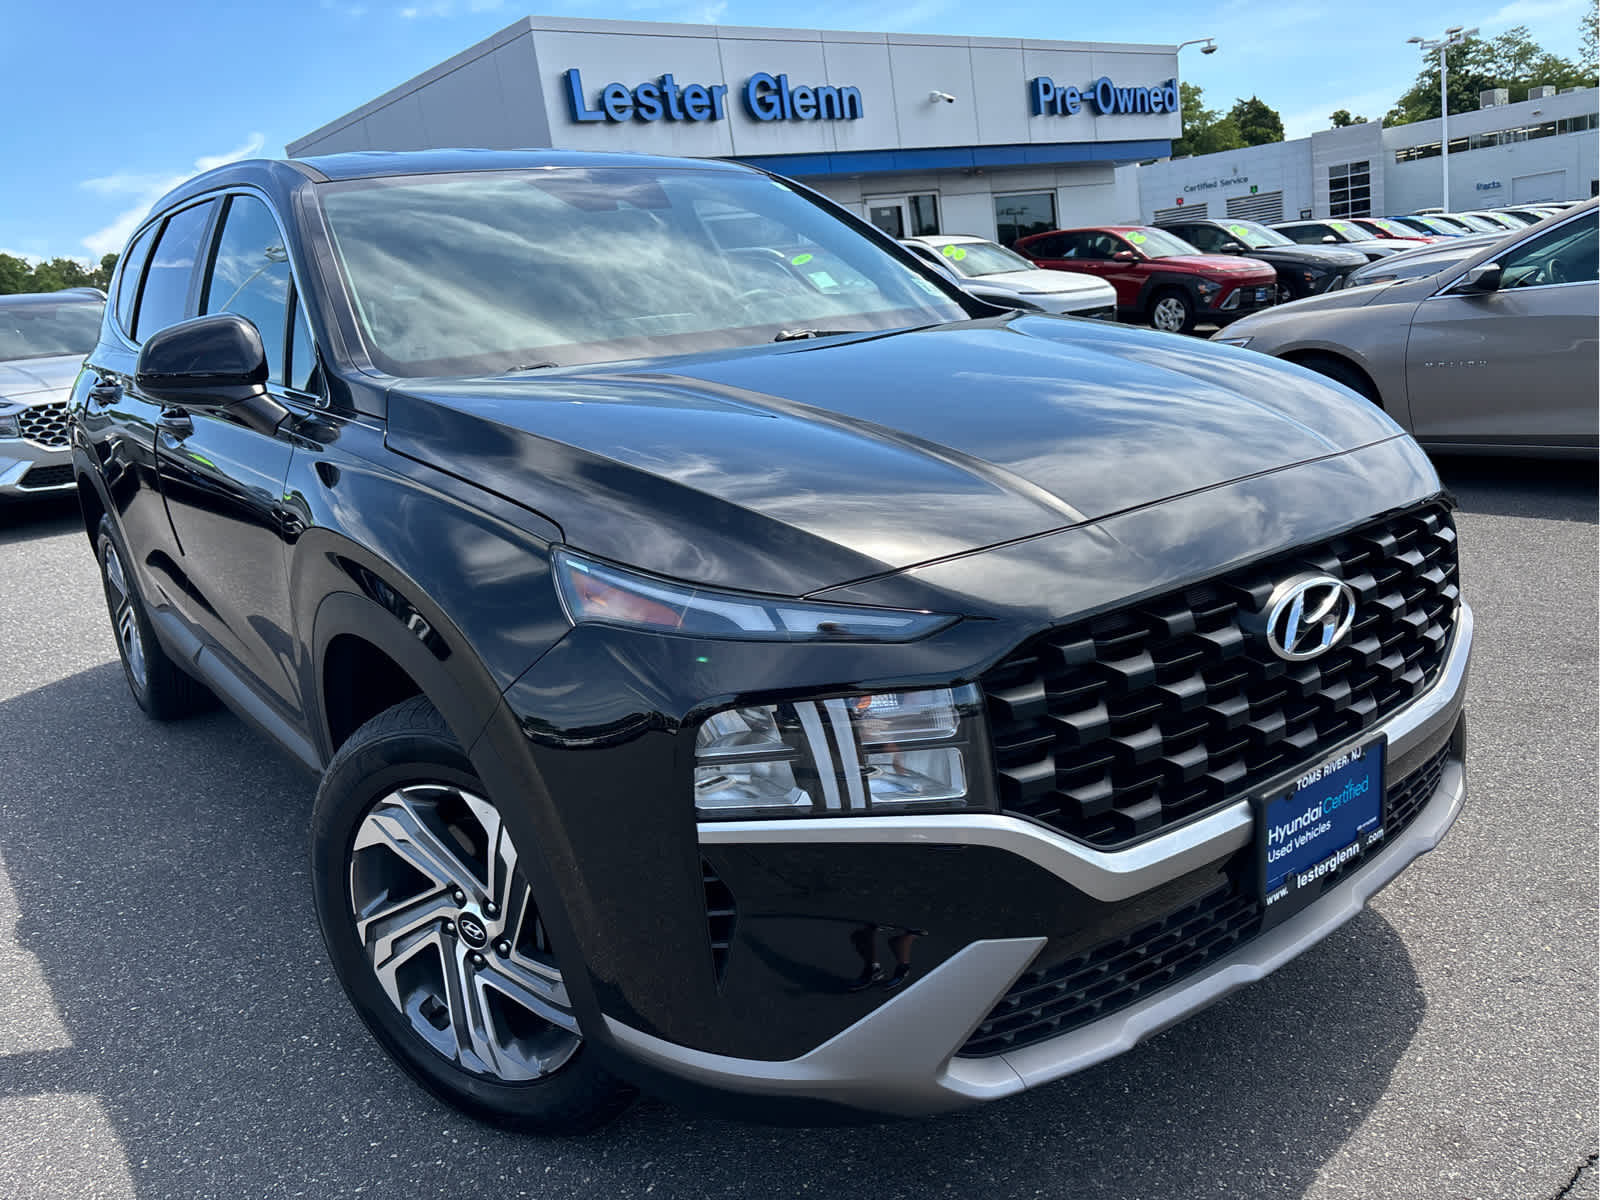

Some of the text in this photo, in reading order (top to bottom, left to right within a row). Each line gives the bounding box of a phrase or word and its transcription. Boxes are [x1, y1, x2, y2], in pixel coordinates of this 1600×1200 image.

[566, 68, 864, 122] Lester Glenn
[1031, 76, 1178, 116] Pre-Owned
[1184, 177, 1248, 192] Certified Service
[1297, 774, 1322, 791] TOMS
[1351, 746, 1363, 761] NJ
[1268, 775, 1369, 846] Hyundai Certified
[1267, 839, 1293, 863] Used
[1294, 820, 1332, 849] Vehicles
[1266, 888, 1289, 906] www.
[1297, 843, 1360, 889] lesterglenn
